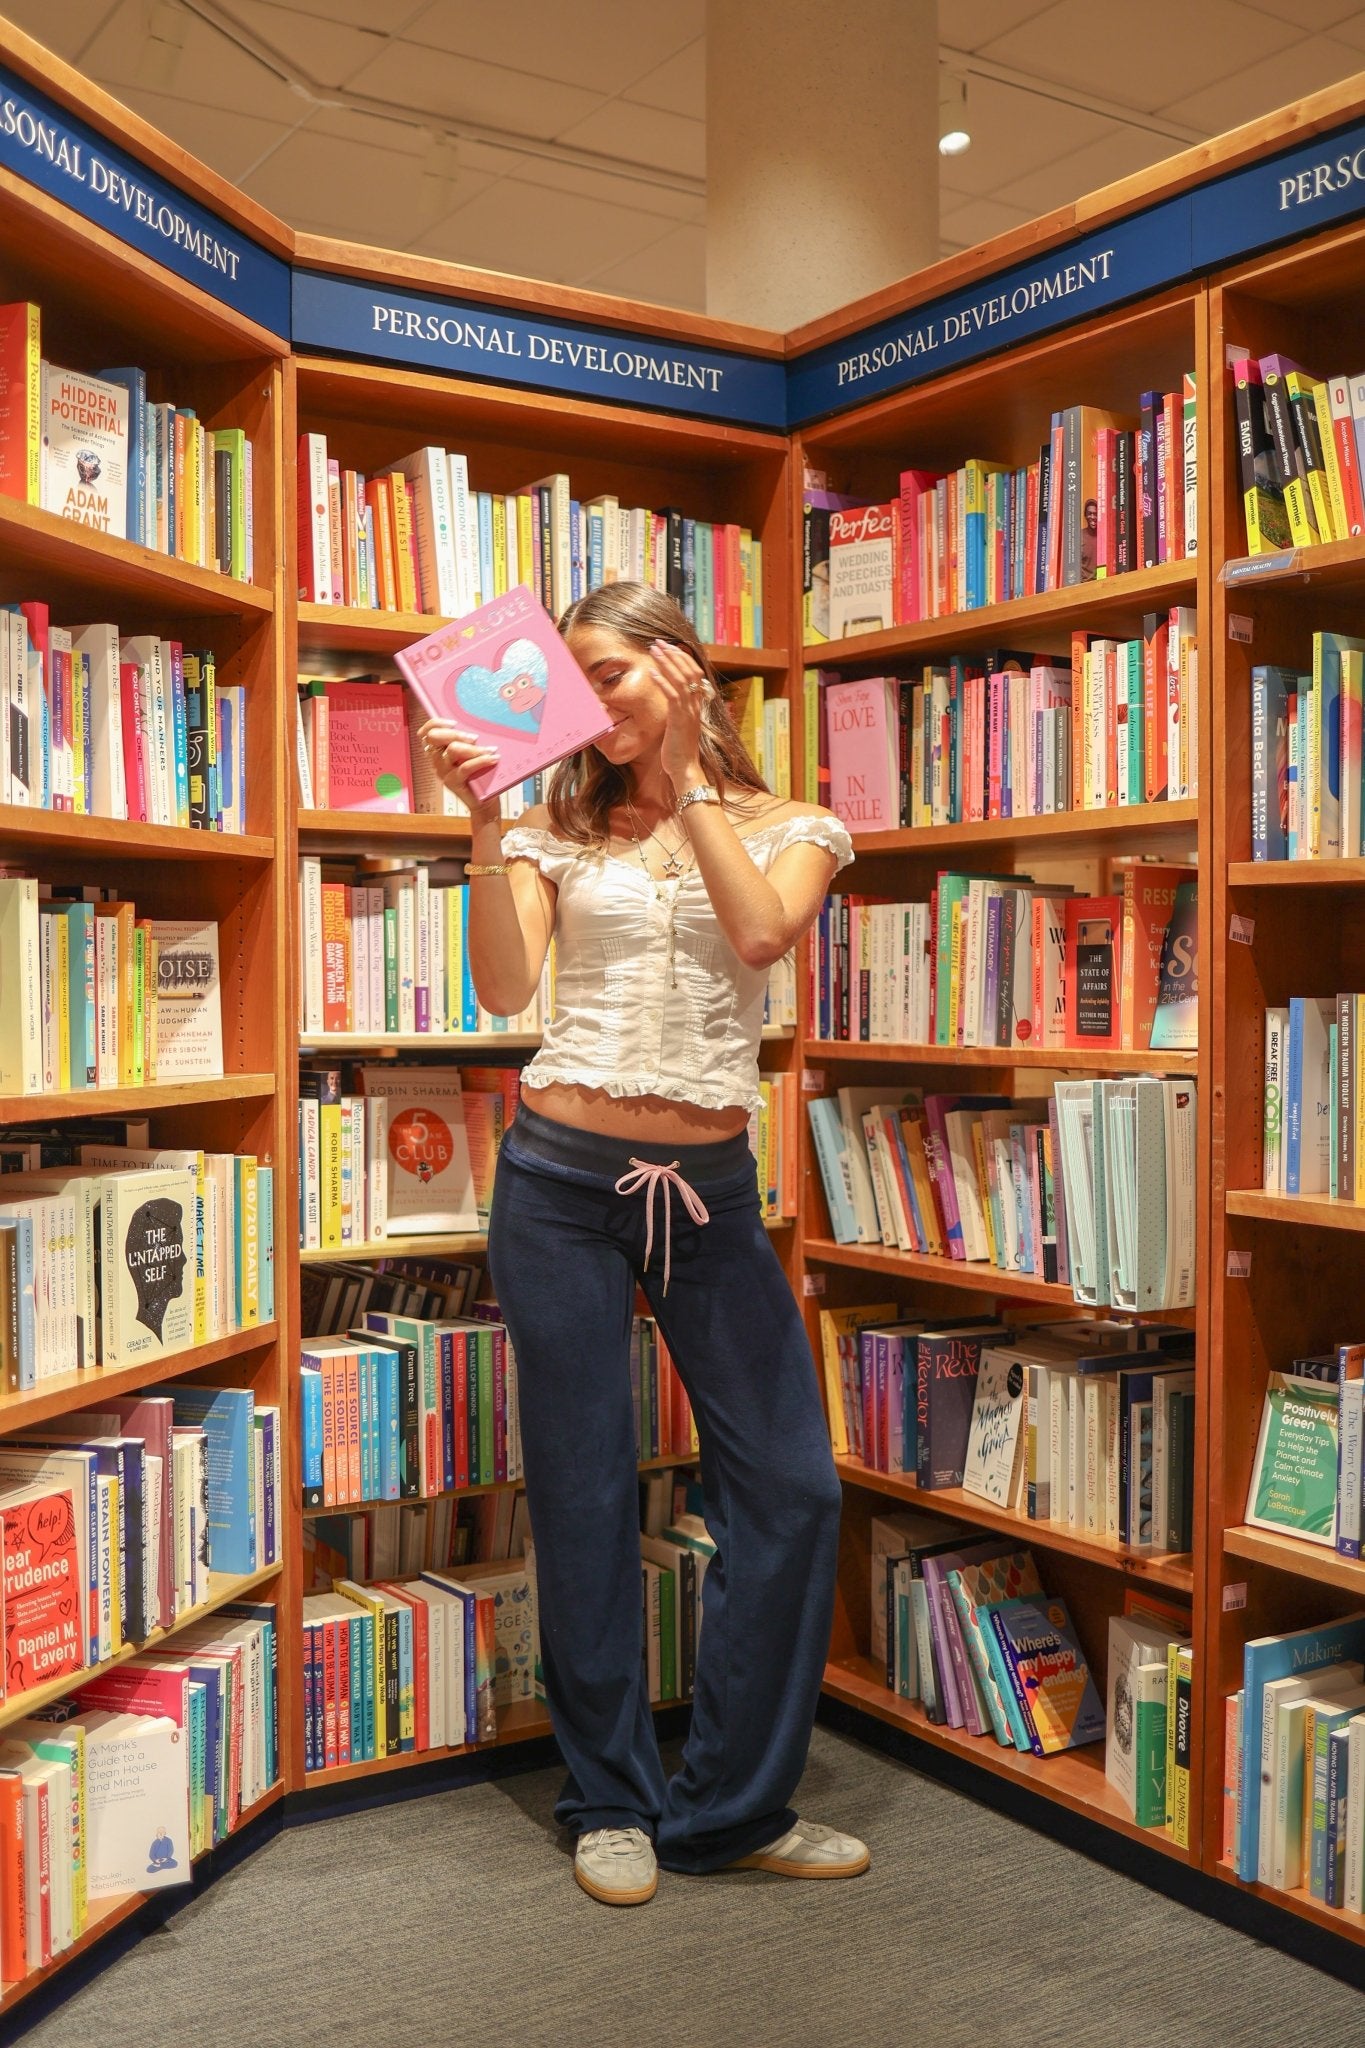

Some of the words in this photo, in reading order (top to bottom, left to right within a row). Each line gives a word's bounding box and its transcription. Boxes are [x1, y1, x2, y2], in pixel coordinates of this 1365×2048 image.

[90, 156, 239, 280] DEVELOPMENT
[837, 323, 939, 386] PERSONAL
[943, 250, 1113, 344] DEVELOPMENT
[29, 317, 39, 358] Toxic
[372, 305, 521, 357] PERSONAL
[528, 333, 723, 393] DEVELOPMENT
[29, 360, 39, 441] Positivity
[61, 382, 117, 415] HIDDEN
[1271, 392, 1280, 421] Cognitive
[51, 399, 124, 438] POTENTIAL
[61, 423, 70, 433] The
[71, 425, 87, 436] Science
[95, 431, 116, 446] Achieving
[1185, 422, 1196, 456] Sex
[1240, 420, 1253, 456] EMDR
[1275, 423, 1288, 456] Behavioural
[1340, 421, 1348, 445] Alcohol
[1185, 461, 1197, 493] Talk
[1283, 457, 1291, 476] Therapy
[66, 488, 108, 515] ADAM
[1289, 486, 1301, 526] dummies
[62, 506, 110, 533] GRANT
[395, 485, 408, 552] MANIFEST
[830, 506, 892, 543] Perfec
[839, 550, 888, 568] WEDDING
[836, 564, 891, 584] SPEECHES
[833, 584, 853, 598] AND
[409, 634, 461, 670] HOW
[479, 598, 530, 633] LOVE
[833, 706, 876, 732] LOVE
[1253, 677, 1264, 736] Martha
[330, 720, 349, 730] The
[330, 732, 357, 741] Book
[330, 744, 349, 753] You
[352, 744, 379, 754] Want
[331, 754, 379, 766] Everyone
[1254, 741, 1264, 780] Beck
[331, 766, 349, 775] You
[332, 778, 344, 786] To
[348, 778, 372, 786] Read
[848, 775, 865, 797] IN
[835, 799, 882, 822] EXILE
[1124, 871, 1134, 933] RESPECT
[325, 892, 334, 940] ROBBINS
[336, 891, 344, 940] ANTHONY
[986, 910, 995, 971] MULTIAMORY
[326, 942, 334, 968] GIANT
[335, 942, 344, 983] AWAKEN
[1089, 955, 1102, 963] THE
[159, 960, 210, 978] OISE
[327, 971, 335, 1003] WITHIN
[336, 986, 344, 1003] THE
[1082, 983, 1107, 991] AFFAIRS
[1270, 1062, 1278, 1081] FREE
[370, 1087, 408, 1096] ROBIN
[413, 1087, 460, 1096] SHARMA
[1264, 1084, 1281, 1133] OCD
[411, 1113, 428, 1143] 5
[397, 1145, 448, 1161] CLUB
[196, 1196, 205, 1235] MAKE
[247, 1179, 257, 1240] 80/20
[146, 1228, 166, 1244] THE
[128, 1244, 182, 1266] UNTAPPED
[196, 1240, 205, 1277] TIME
[145, 1266, 167, 1283] SELF
[247, 1242, 257, 1300] DAILY
[917, 1357, 932, 1428] Reactor
[1281, 1415, 1315, 1431] Green
[1283, 1402, 1338, 1425] Positively
[981, 1427, 1013, 1468] Grief
[1279, 1429, 1313, 1445] Everyday
[1314, 1436, 1330, 1446] Tips
[1272, 1471, 1300, 1486] Anxiety
[37, 1507, 61, 1528] help!
[101, 1488, 109, 1542] BRAIN
[102, 1549, 110, 1610] POWER
[18, 1630, 60, 1657] Daniel
[63, 1623, 77, 1639] M.
[339, 1628, 347, 1645] HOW
[1011, 1633, 1061, 1653] Where's
[32, 1641, 77, 1671] Lavery
[340, 1647, 348, 1658] TO
[340, 1660, 348, 1669] BE
[1019, 1658, 1038, 1671] my
[1039, 1649, 1076, 1671] happy
[1293, 1640, 1342, 1668] Making
[339, 1671, 348, 1699] HUMAN
[1043, 1664, 1089, 1687] ending?
[340, 1709, 349, 1728] RUBY
[1178, 1697, 1189, 1751] Divorce
[1262, 1691, 1273, 1762] Gaslighting
[88, 1745, 98, 1756] A
[101, 1741, 138, 1755] Monk's
[340, 1729, 349, 1747] WAX
[88, 1756, 119, 1769] Guide
[123, 1753, 134, 1762] to
[88, 1767, 120, 1781] Clean
[123, 1762, 157, 1775] House
[88, 1780, 109, 1793] and
[113, 1777, 140, 1791] Mind
